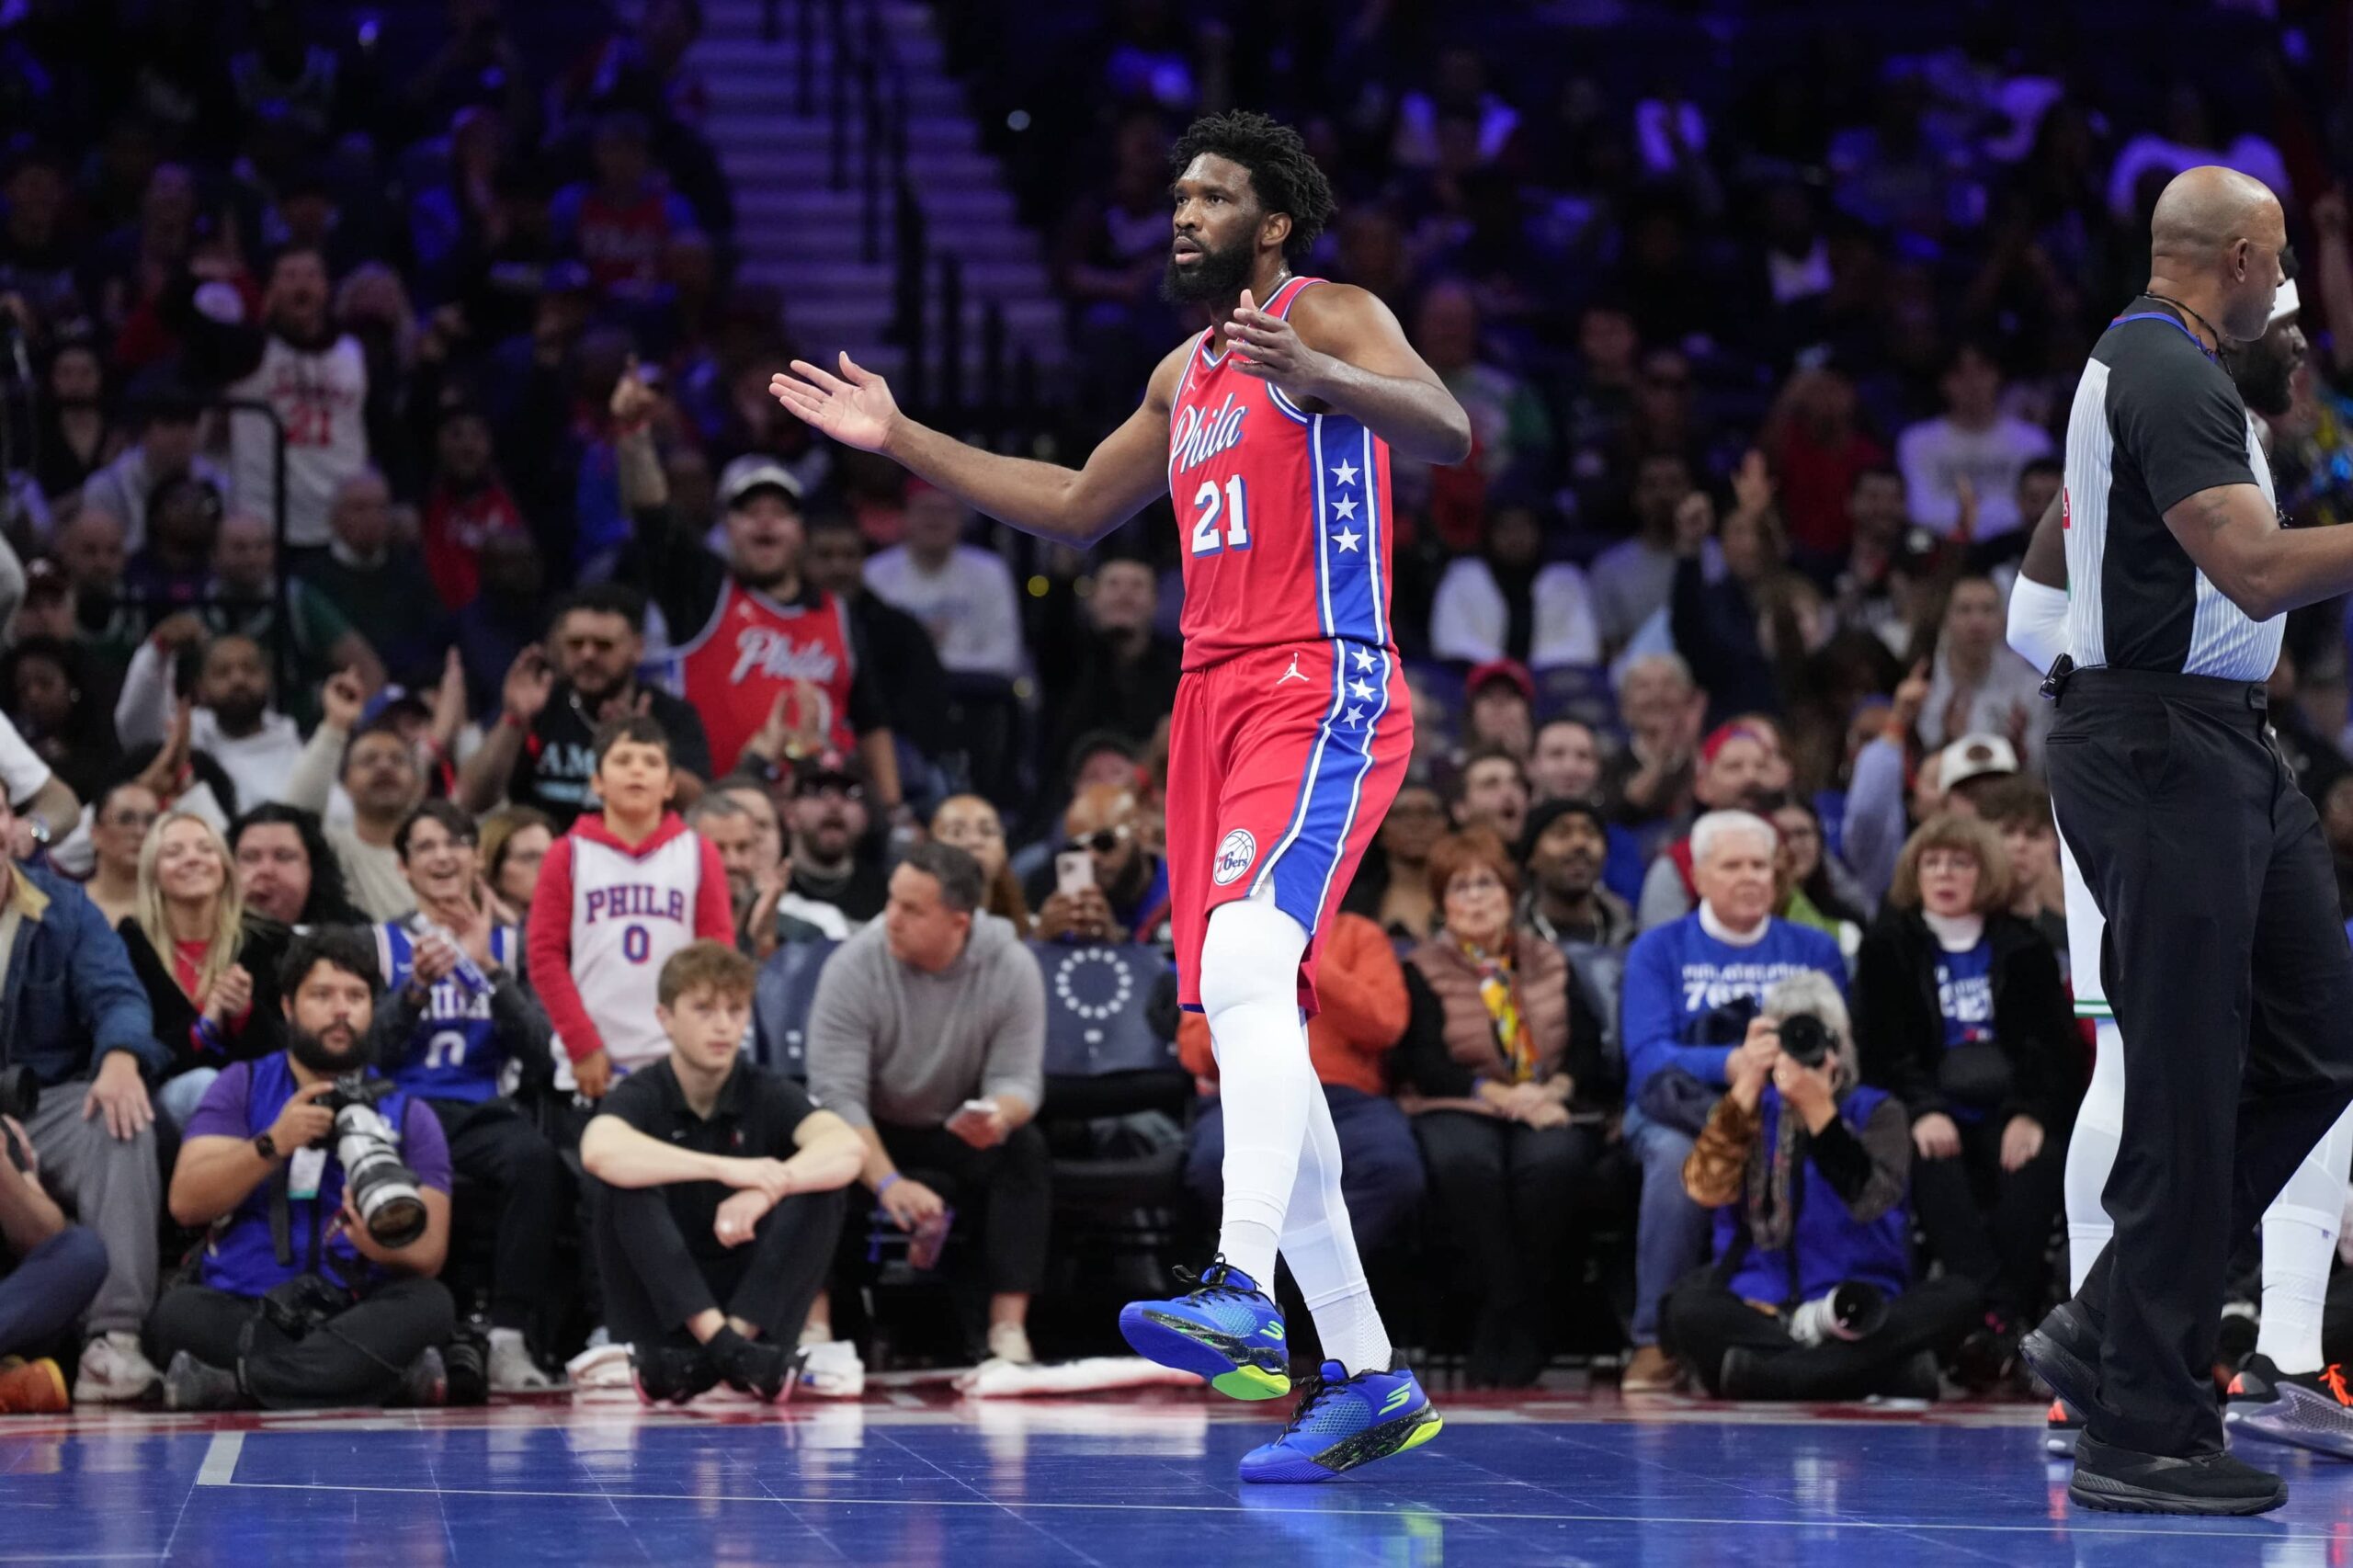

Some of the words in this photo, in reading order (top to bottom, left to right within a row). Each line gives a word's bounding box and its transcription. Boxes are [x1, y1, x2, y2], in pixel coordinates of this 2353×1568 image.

[1171, 392, 1247, 473] Phila
[1192, 474, 1251, 557] 21
[585, 883, 684, 925] PHILA
[623, 924, 651, 965] 0
